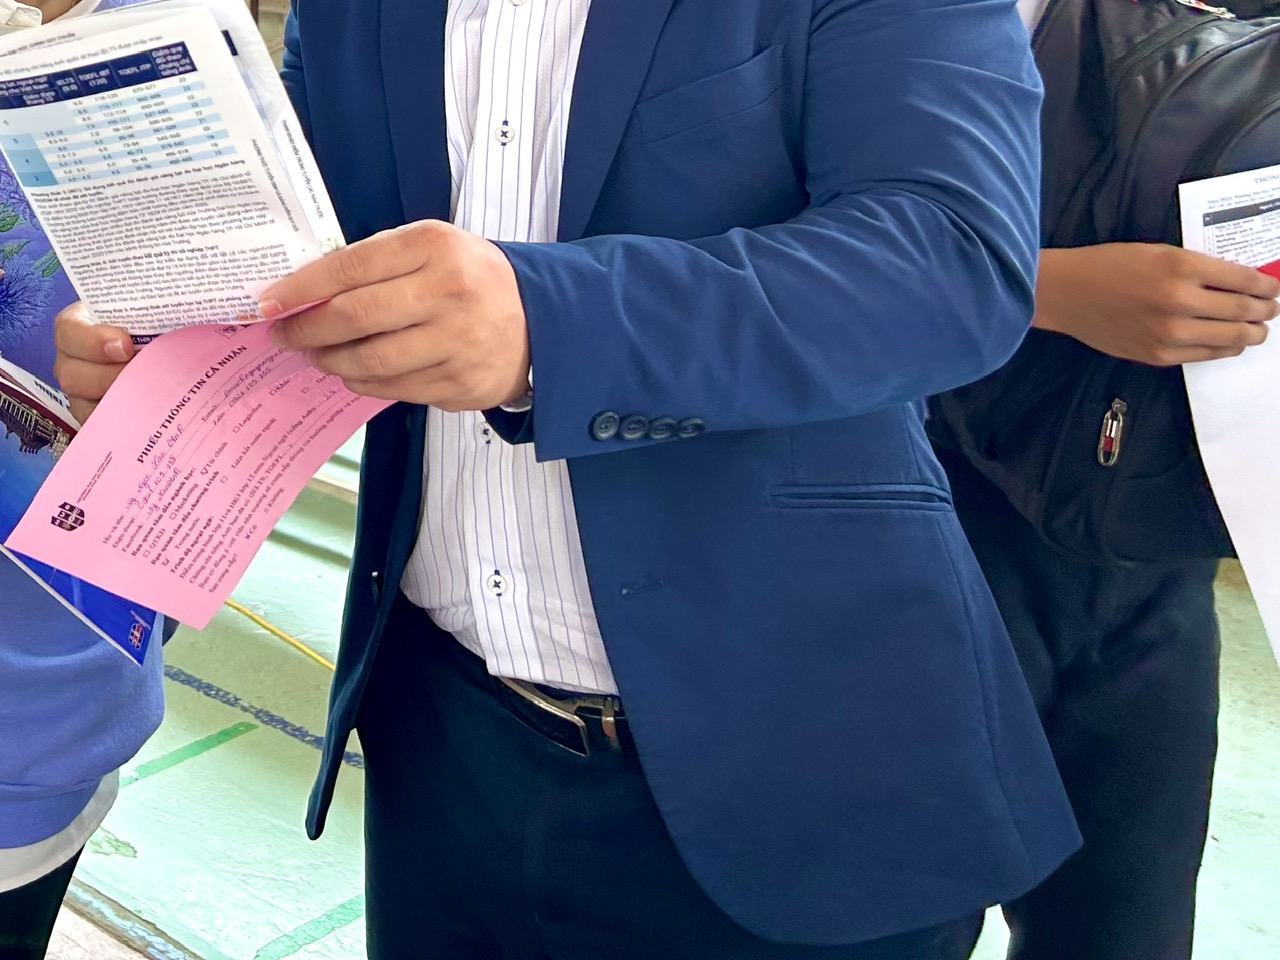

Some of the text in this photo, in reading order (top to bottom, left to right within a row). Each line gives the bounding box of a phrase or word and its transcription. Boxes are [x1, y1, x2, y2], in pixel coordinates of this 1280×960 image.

[137, 431, 162, 463] PHIẾU
[160, 395, 190, 429] THÔNG
[188, 378, 206, 394] TIN
[205, 366, 220, 379] CÁ
[217, 345, 247, 367] NHÂN
